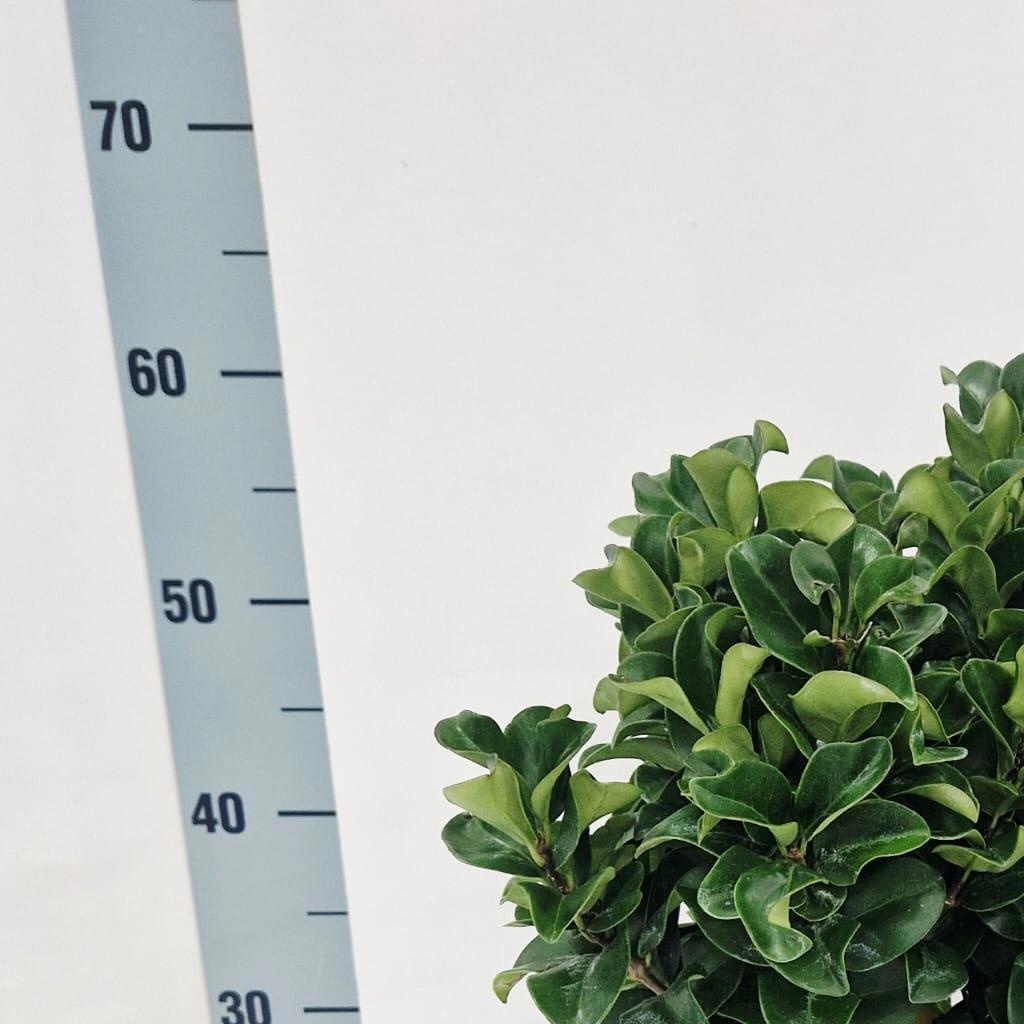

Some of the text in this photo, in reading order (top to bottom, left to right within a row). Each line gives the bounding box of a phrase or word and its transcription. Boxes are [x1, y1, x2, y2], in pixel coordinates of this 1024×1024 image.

[90, 99, 152, 153] 70
[127, 347, 187, 397] 60
[161, 578, 217, 624] 50
[191, 792, 246, 834] 40
